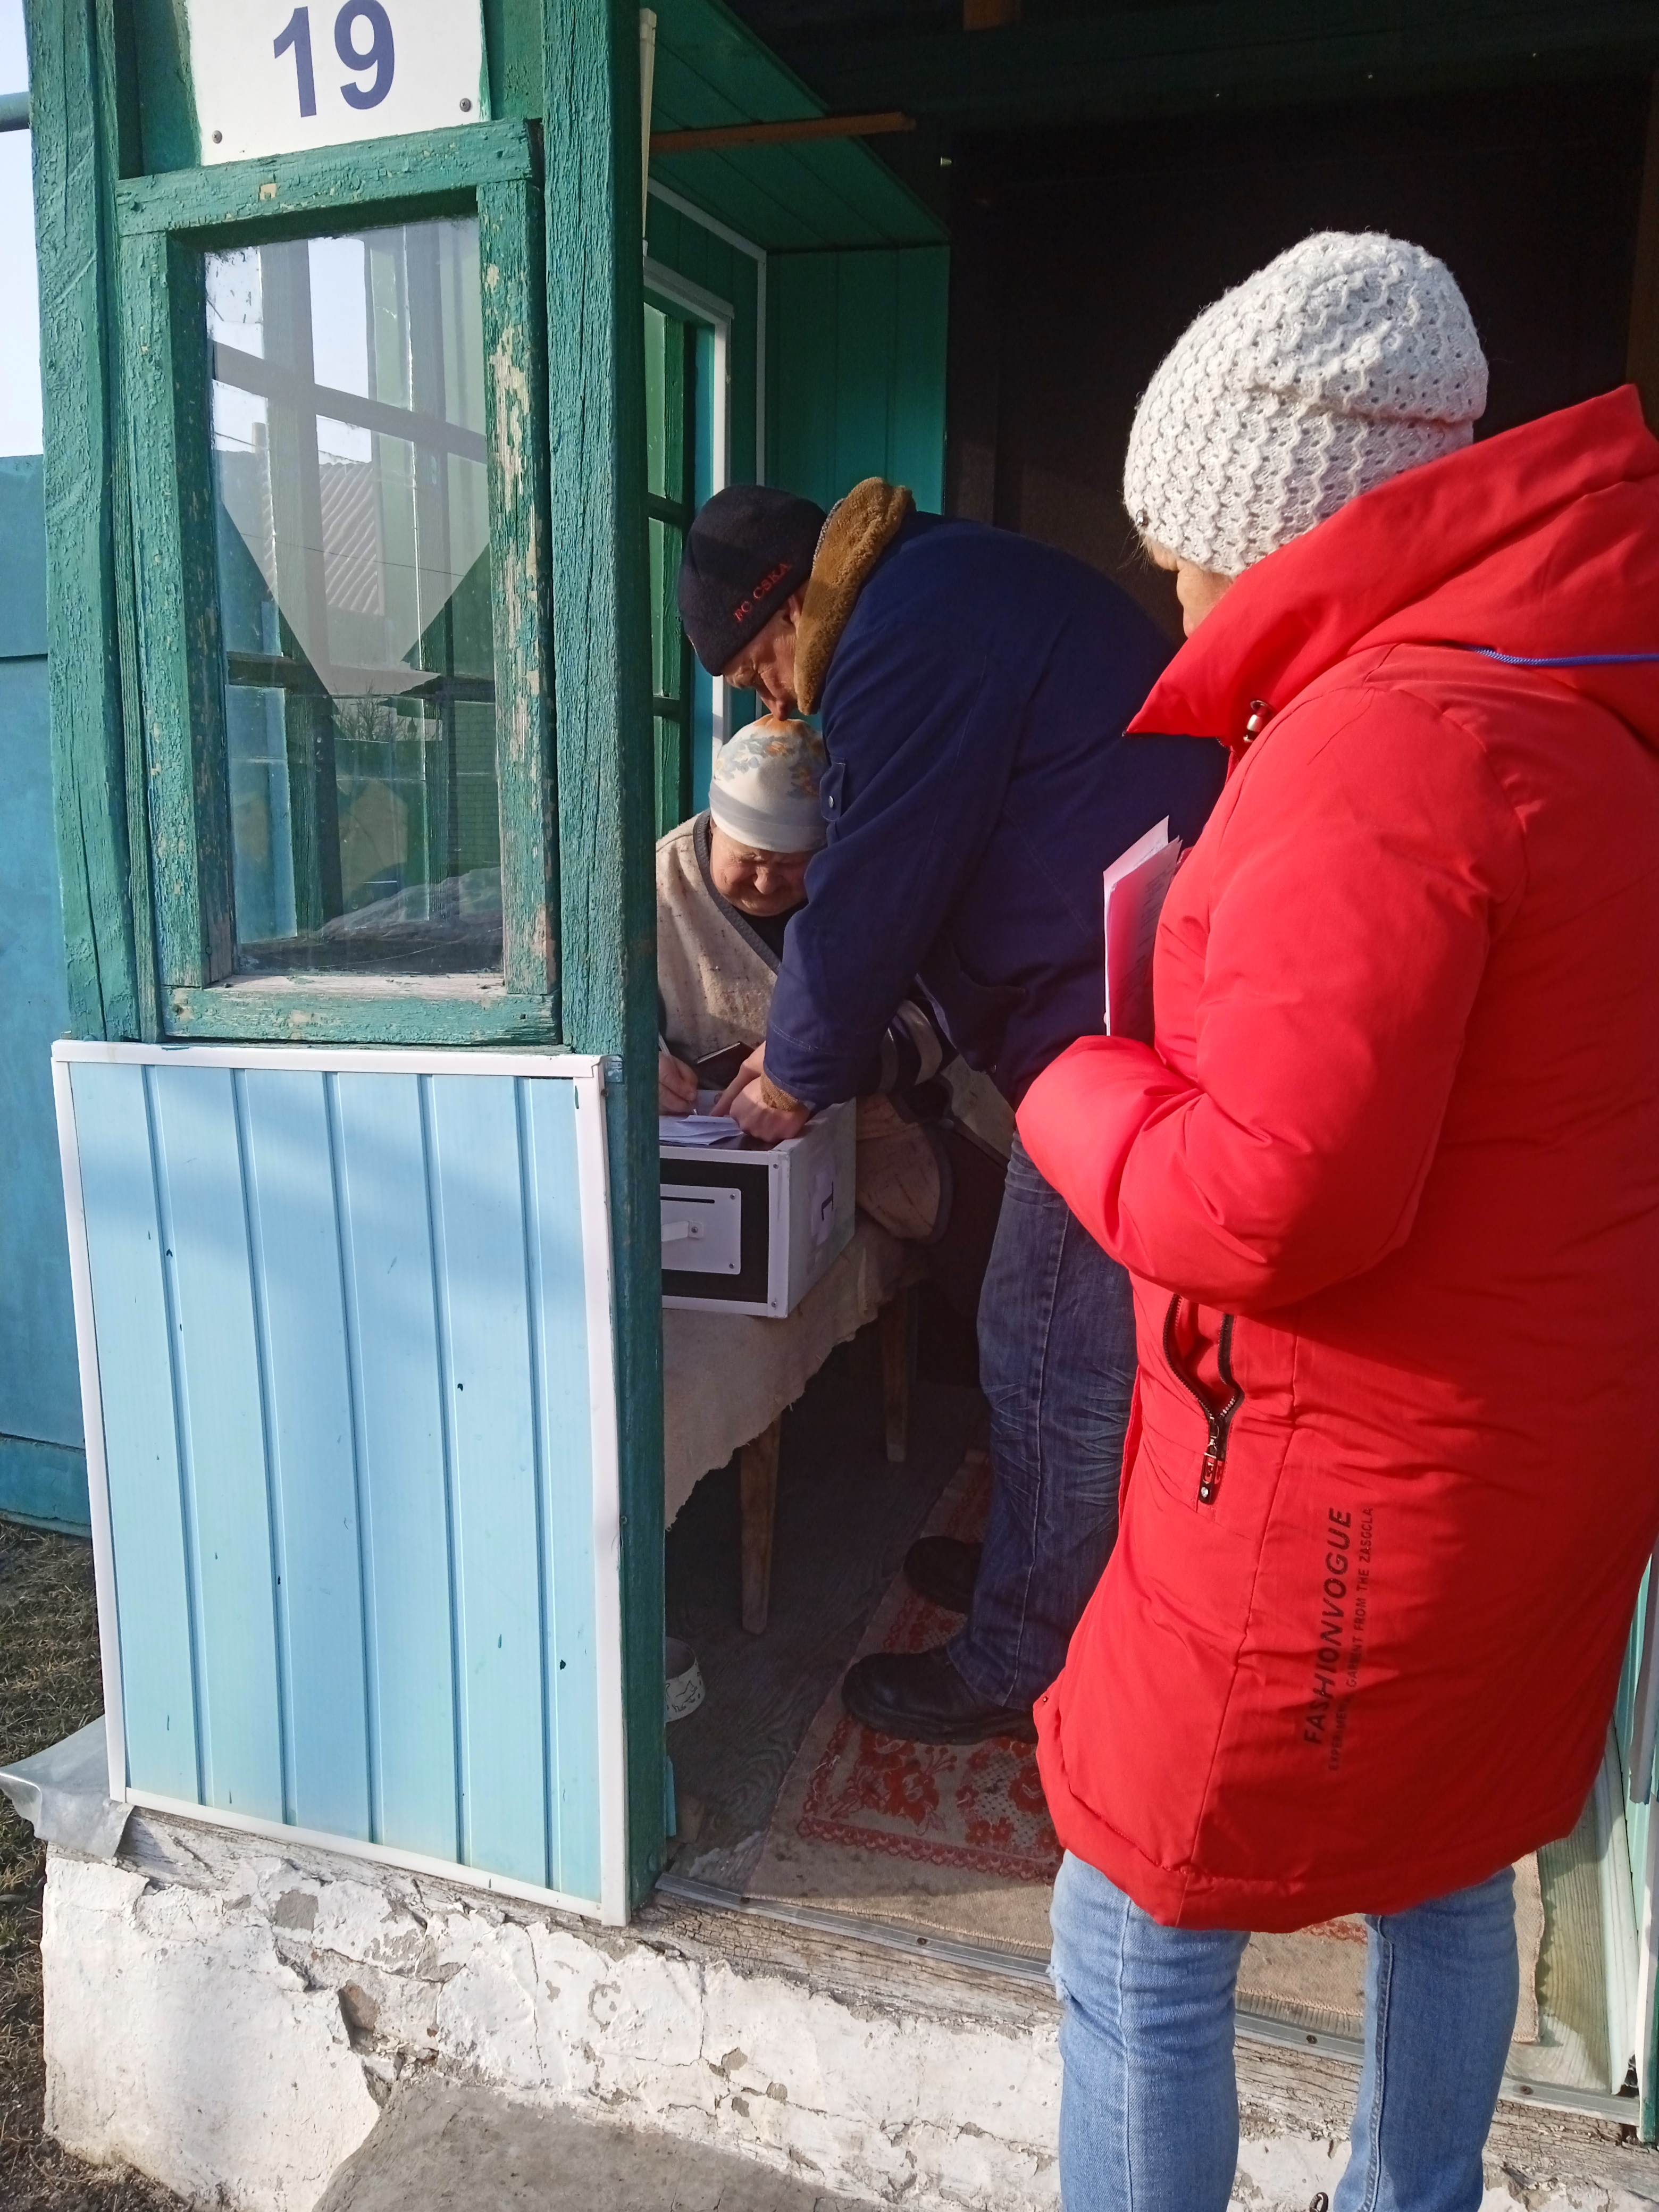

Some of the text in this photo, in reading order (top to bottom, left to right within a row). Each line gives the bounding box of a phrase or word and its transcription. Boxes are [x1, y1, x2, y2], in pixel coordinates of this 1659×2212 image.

[273, 0, 395, 118] 19
[1353, 1597, 1367, 1631] FROM
[1356, 1568, 1369, 1591] THE
[1303, 1507, 1352, 1745] FASHIONVOGUE
